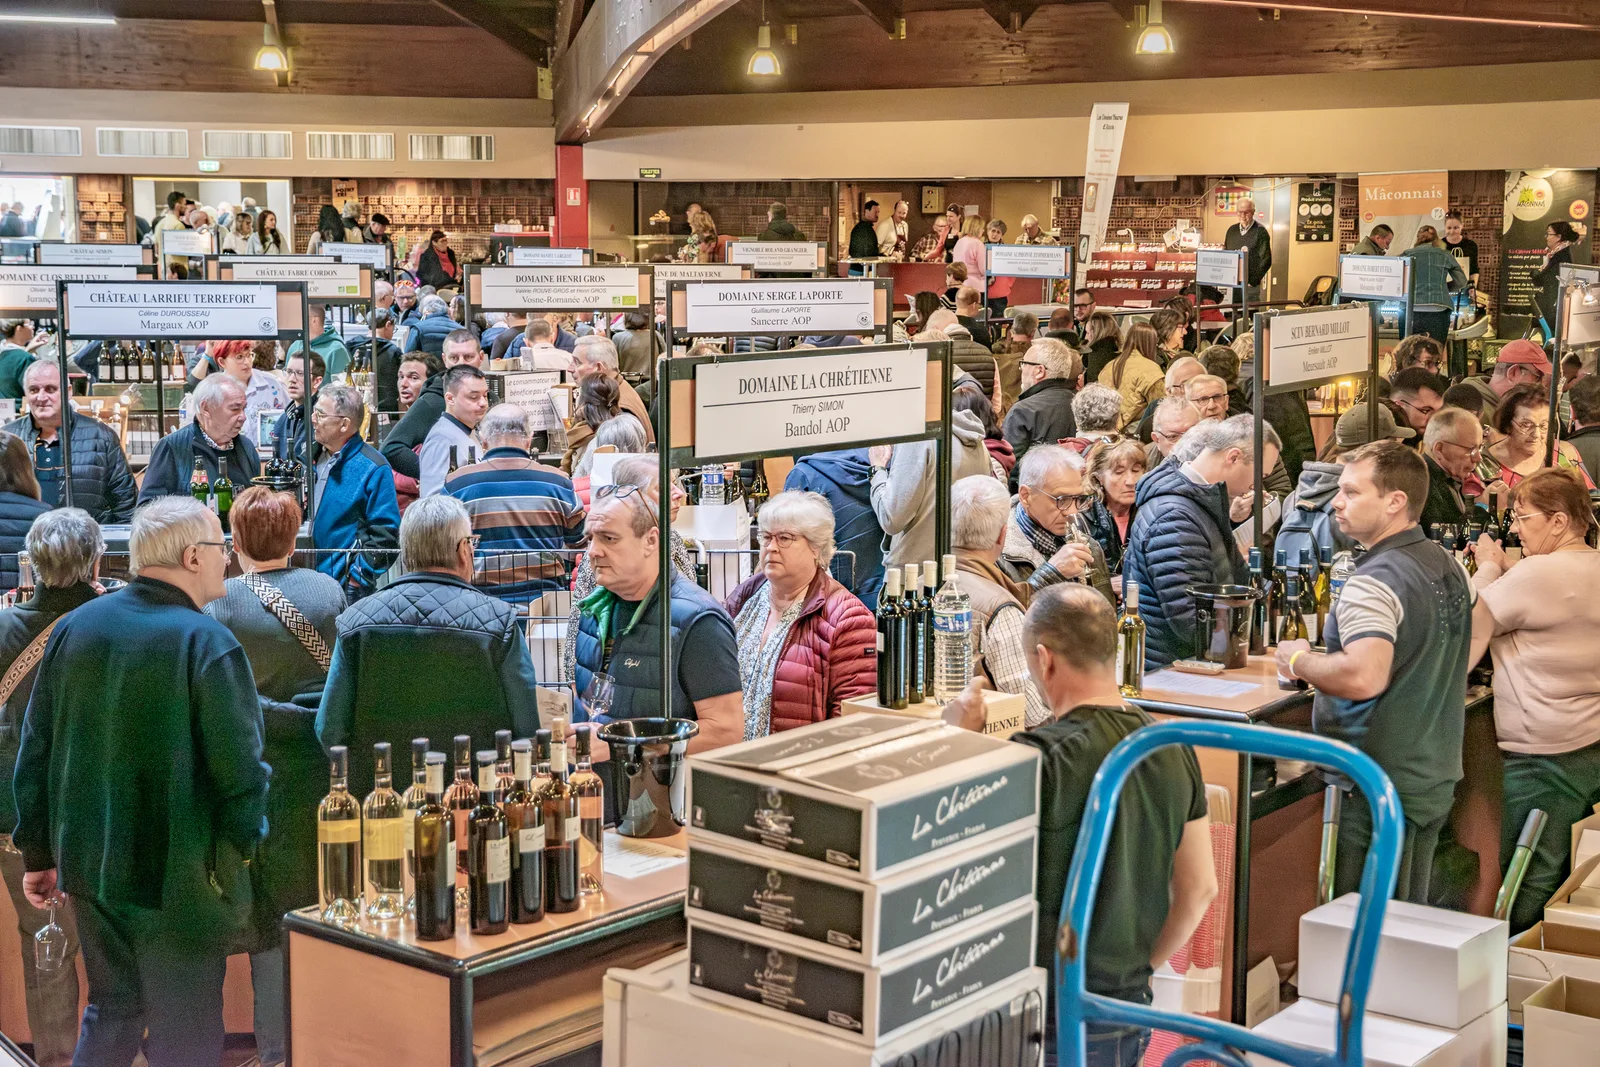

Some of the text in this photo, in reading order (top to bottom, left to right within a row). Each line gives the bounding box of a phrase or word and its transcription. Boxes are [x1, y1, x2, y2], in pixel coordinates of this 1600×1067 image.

[1365, 185, 1443, 201] Mâconnais
[40, 273, 62, 281] CLOS
[255, 268, 285, 276] CHÂTEAU
[515, 275, 605, 283] DOMAINE HENRI GROS
[26, 295, 57, 304] Juranço
[89, 290, 256, 304] CHÂTEAU LARRIEU TERREFORT
[522, 295, 600, 304] Vosne-Romanée AOP
[718, 290, 843, 302] DOMAINE SERGE LAPORTE
[140, 320, 209, 332] Margaux AOP
[751, 316, 812, 326] Sancerre AOP
[1305, 323, 1330, 338] BERNARD
[1330, 321, 1350, 335] MILLOT
[1302, 356, 1338, 373] Meursault AOP
[738, 366, 893, 395] DOMAINE LA CHRÉTIENNE
[792, 400, 844, 415] Thierry SIMON
[784, 416, 850, 438] Bandol AOP
